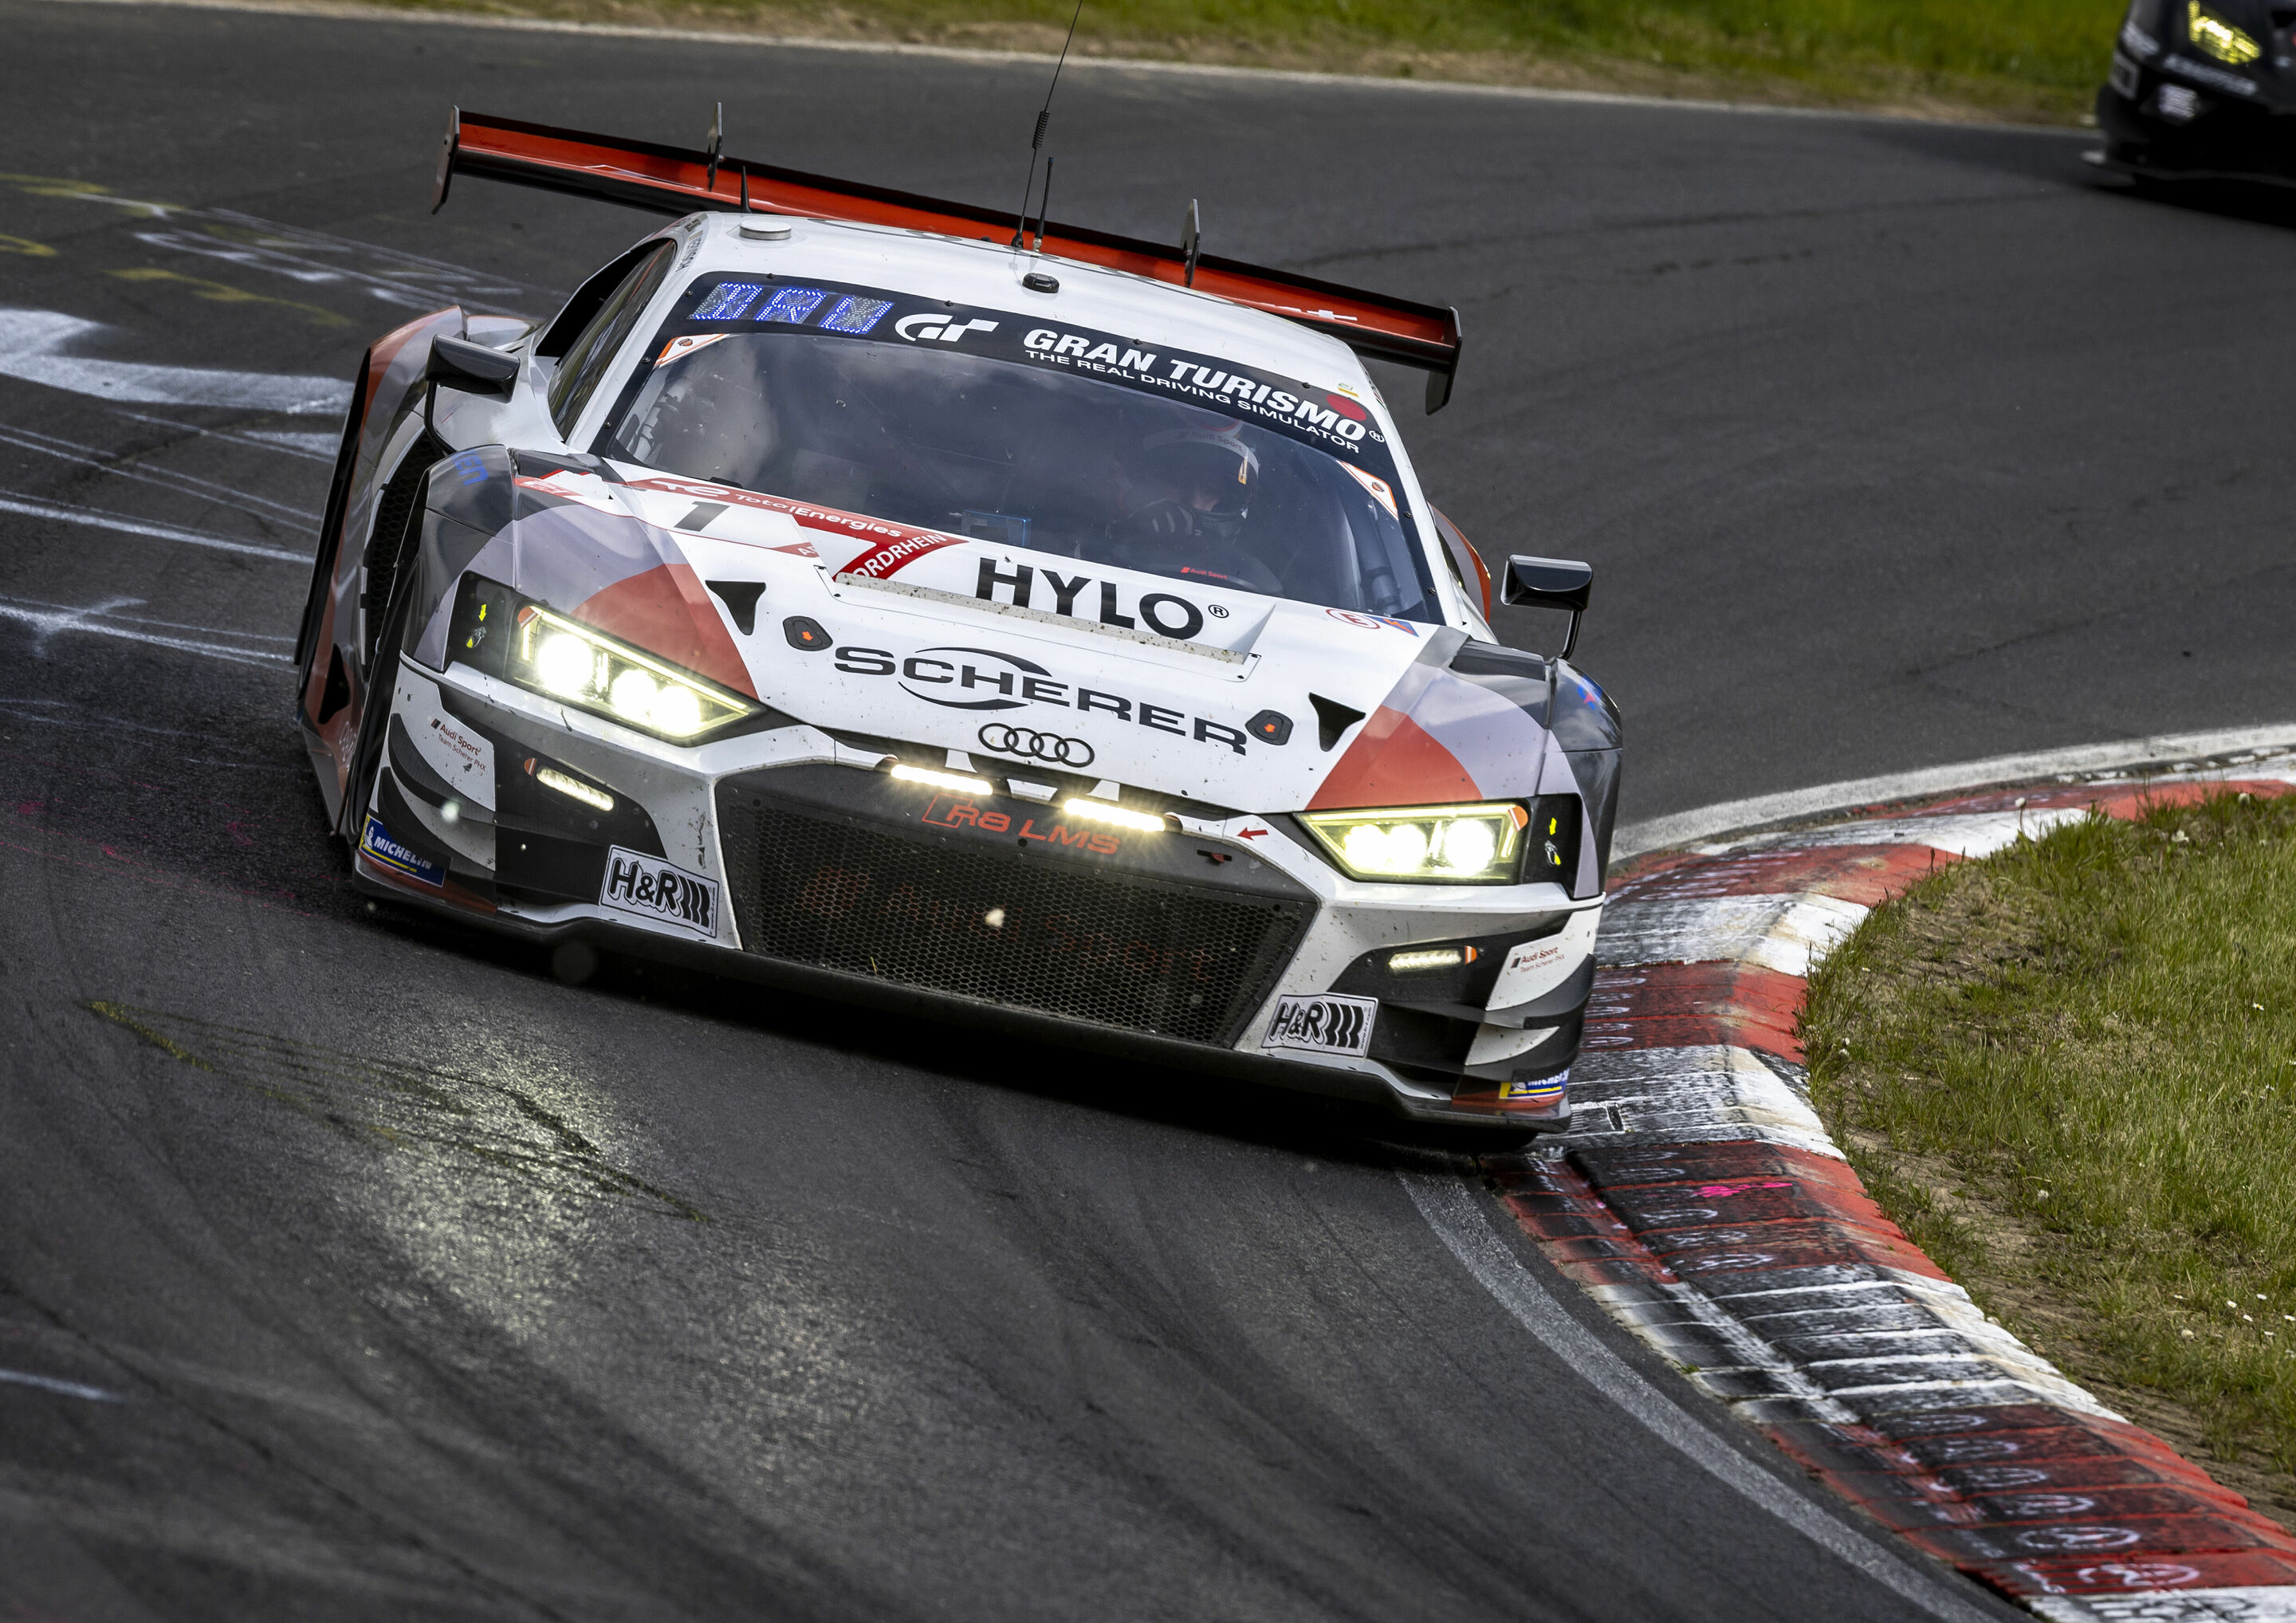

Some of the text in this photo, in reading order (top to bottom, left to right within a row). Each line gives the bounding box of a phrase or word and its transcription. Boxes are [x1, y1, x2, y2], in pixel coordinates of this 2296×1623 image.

[1023, 328, 1157, 372] GRAN
[1025, 349, 1360, 454] THE REAL DRIVING SIMULATOR
[1217, 435, 1244, 452] Sport
[674, 500, 731, 532] 1
[735, 493, 902, 537] TotalEnergies
[834, 646, 1247, 756] SCHERER
[438, 733, 486, 772] Team Scherer PHX
[440, 724, 458, 741] Audi
[944, 802, 1122, 855] R8 LMS
[608, 859, 682, 916] H&R
[1269, 1002, 1327, 1043] H&R
